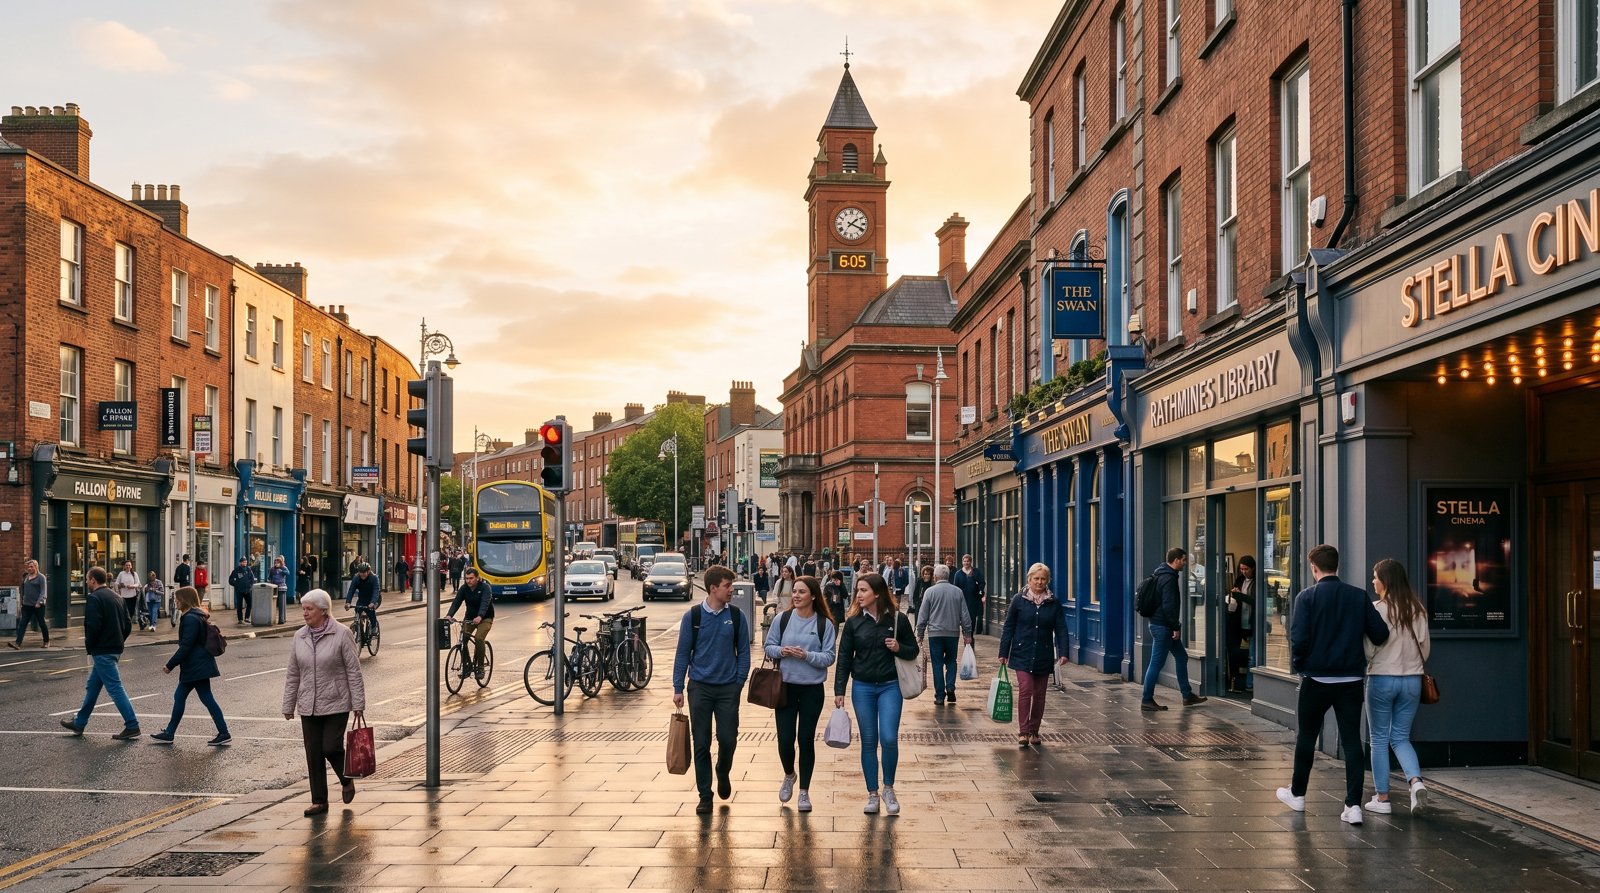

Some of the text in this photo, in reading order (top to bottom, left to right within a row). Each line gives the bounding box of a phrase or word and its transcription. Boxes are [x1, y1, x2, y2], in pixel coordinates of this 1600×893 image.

[1401, 233, 1518, 328] STELLA
[1062, 286, 1092, 298] THE
[1056, 300, 1097, 311] SWAN
[1150, 349, 1280, 428] RATHMINES LIBRARY
[1041, 413, 1091, 455] THE SWAN
[74, 481, 107, 497] FALLON
[116, 485, 142, 500] BYRNE
[1436, 500, 1501, 515] STELLA
[1451, 517, 1486, 525] CINEMA
